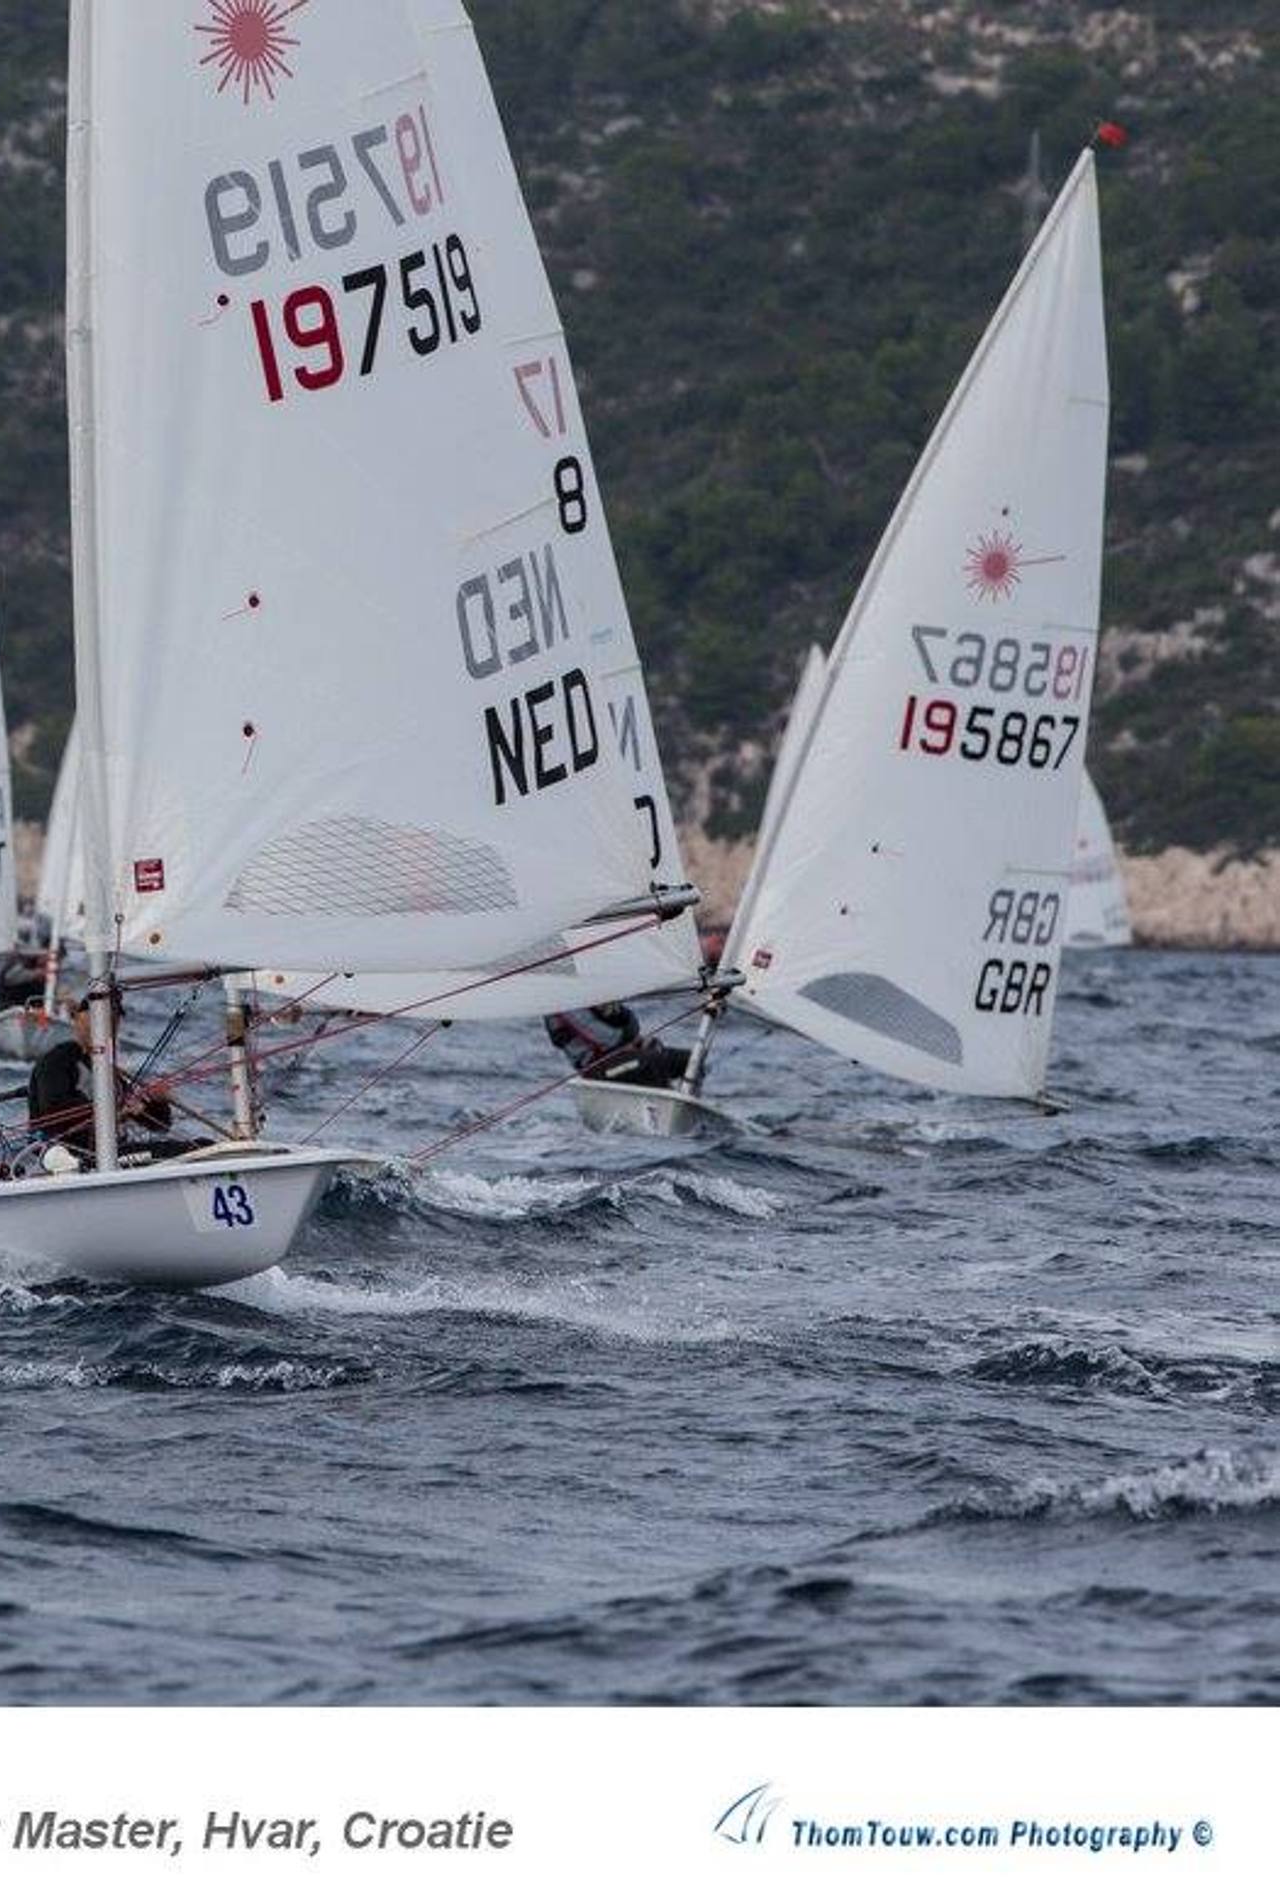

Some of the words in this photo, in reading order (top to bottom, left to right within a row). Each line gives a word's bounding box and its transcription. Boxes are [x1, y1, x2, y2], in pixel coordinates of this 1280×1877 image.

[250, 233, 481, 402] 197519
[484, 667, 600, 805] NED
[899, 695, 1079, 770] 195867
[974, 958, 1052, 1016] GBR
[214, 1185, 254, 1227] 43
